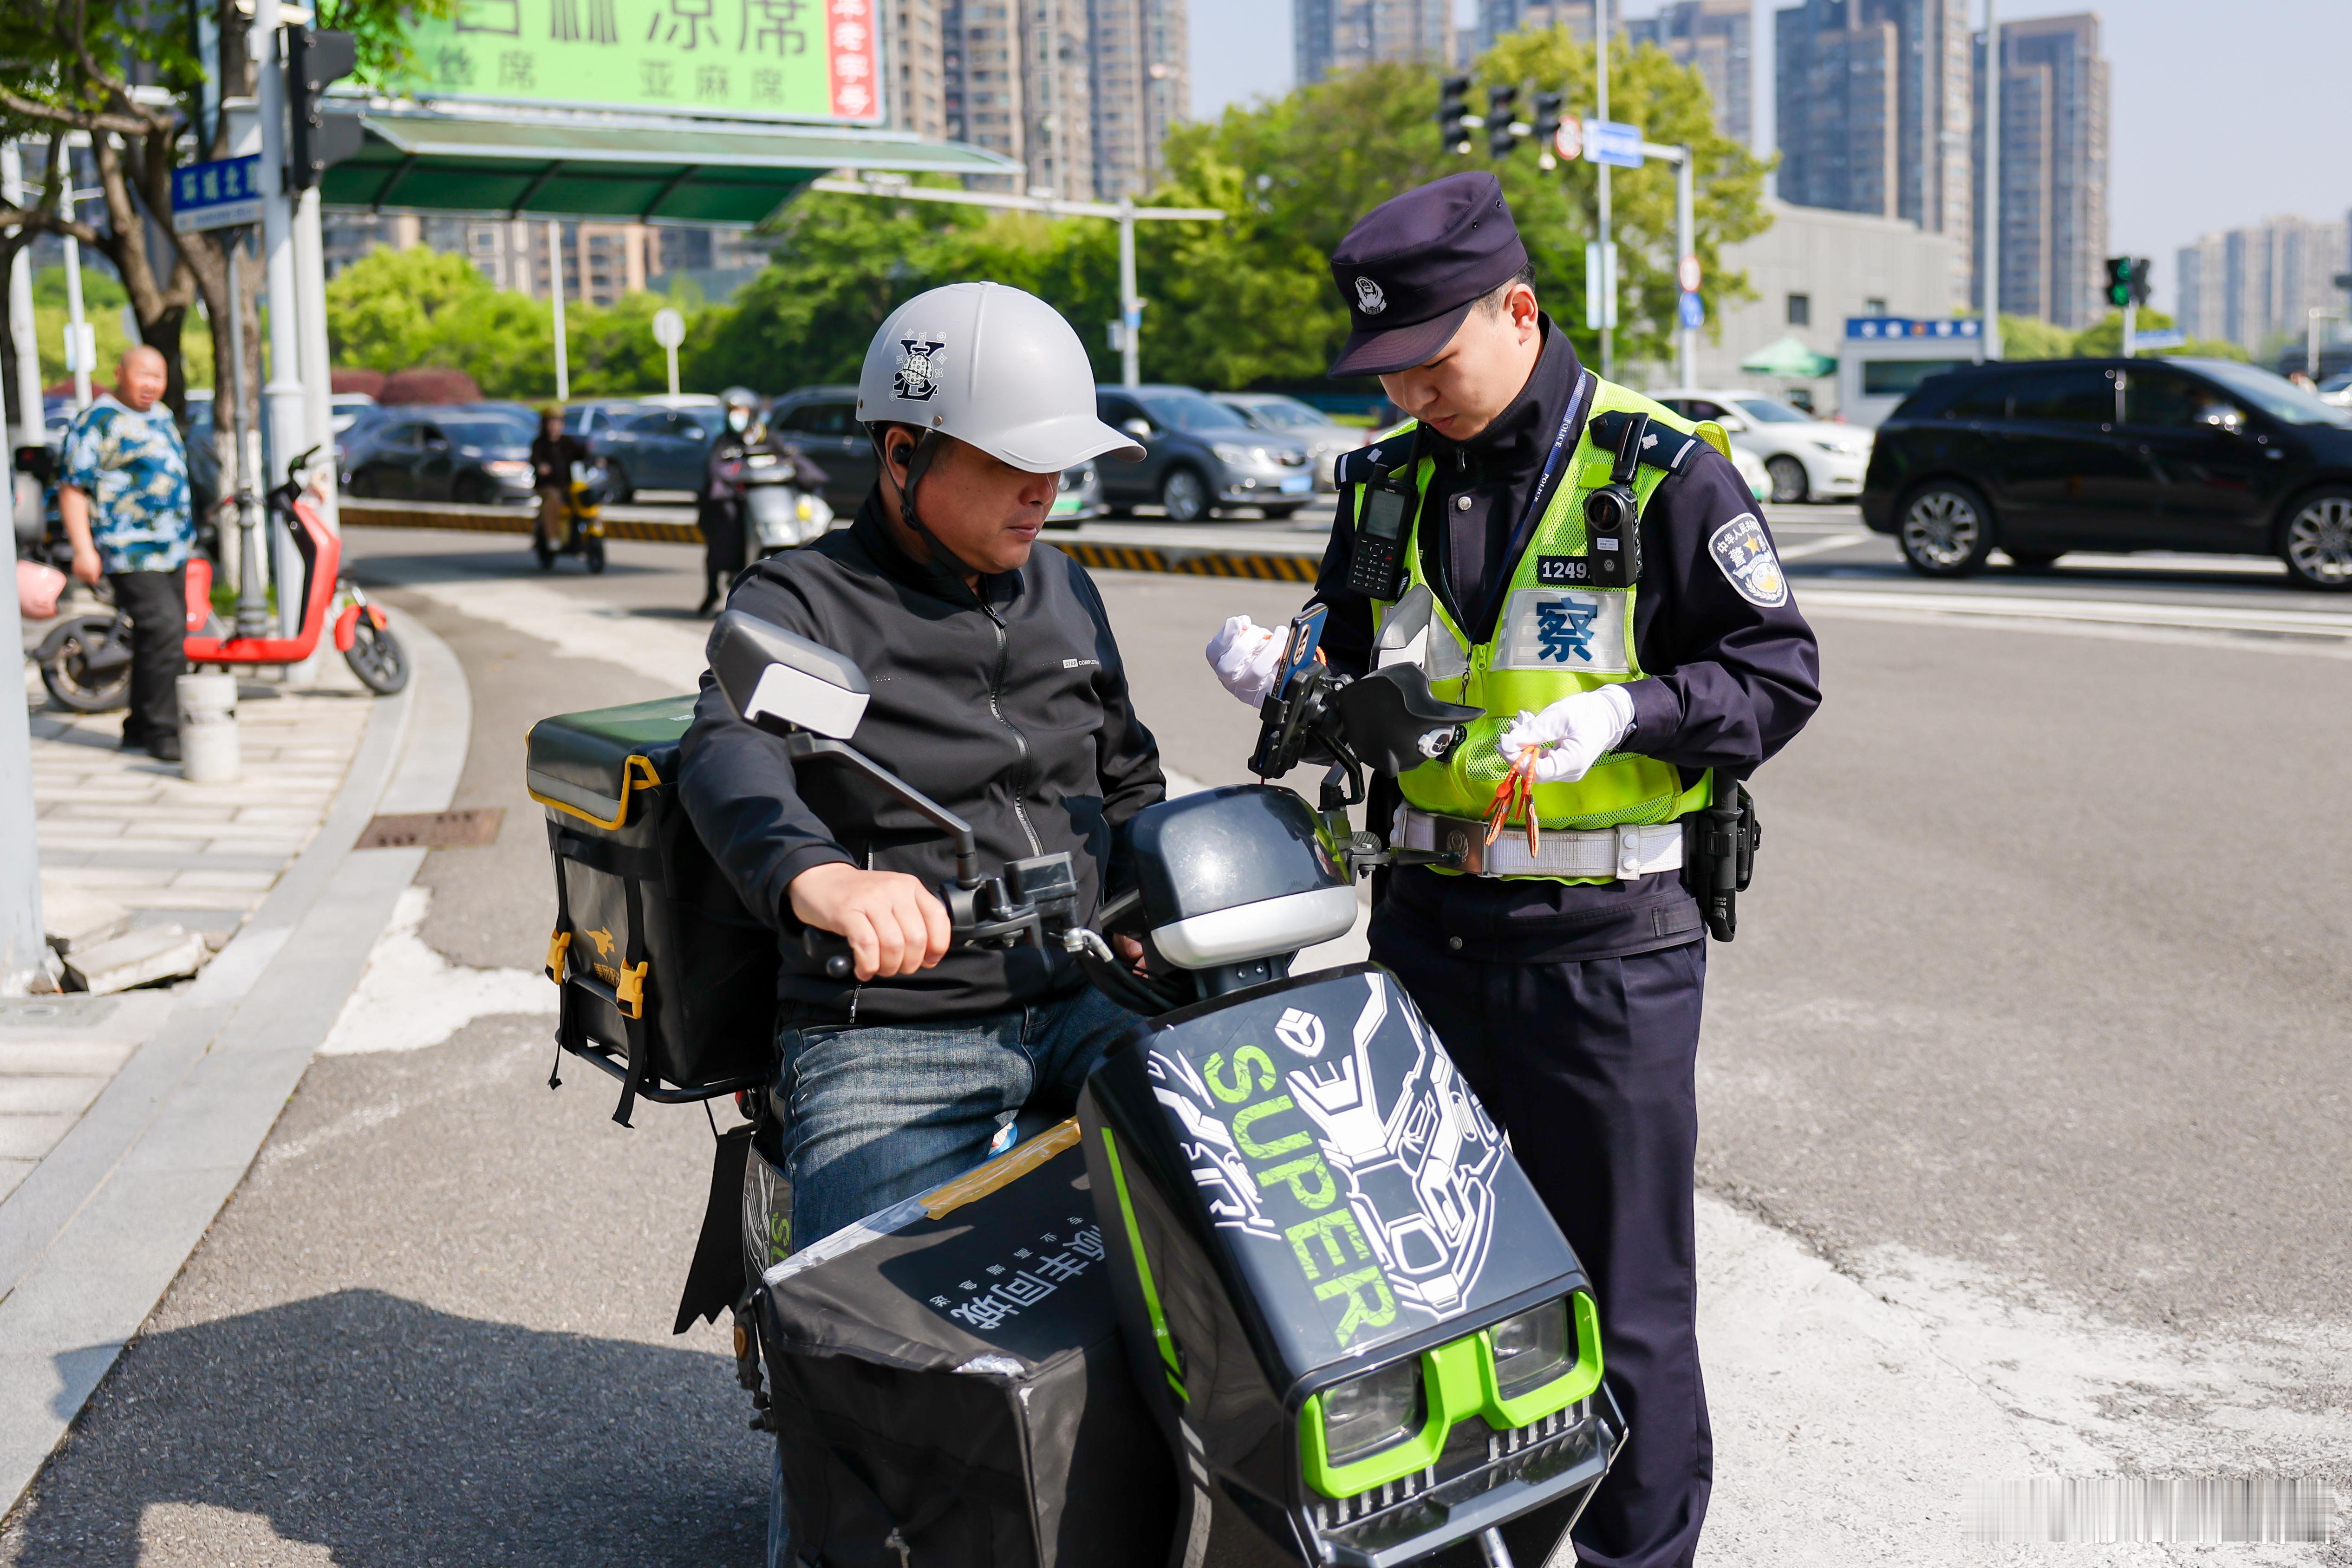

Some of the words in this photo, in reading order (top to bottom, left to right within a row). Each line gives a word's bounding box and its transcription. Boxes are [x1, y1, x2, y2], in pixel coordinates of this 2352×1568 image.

[1534, 473, 1549, 502] POLICE
[1543, 561, 1590, 579] 1249
[1537, 597, 1597, 663] 察
[1204, 1045, 1396, 1347] SUPER
[929, 1217, 1084, 1308] 专业高端急送
[950, 1225, 1106, 1329] 顺丰同城
